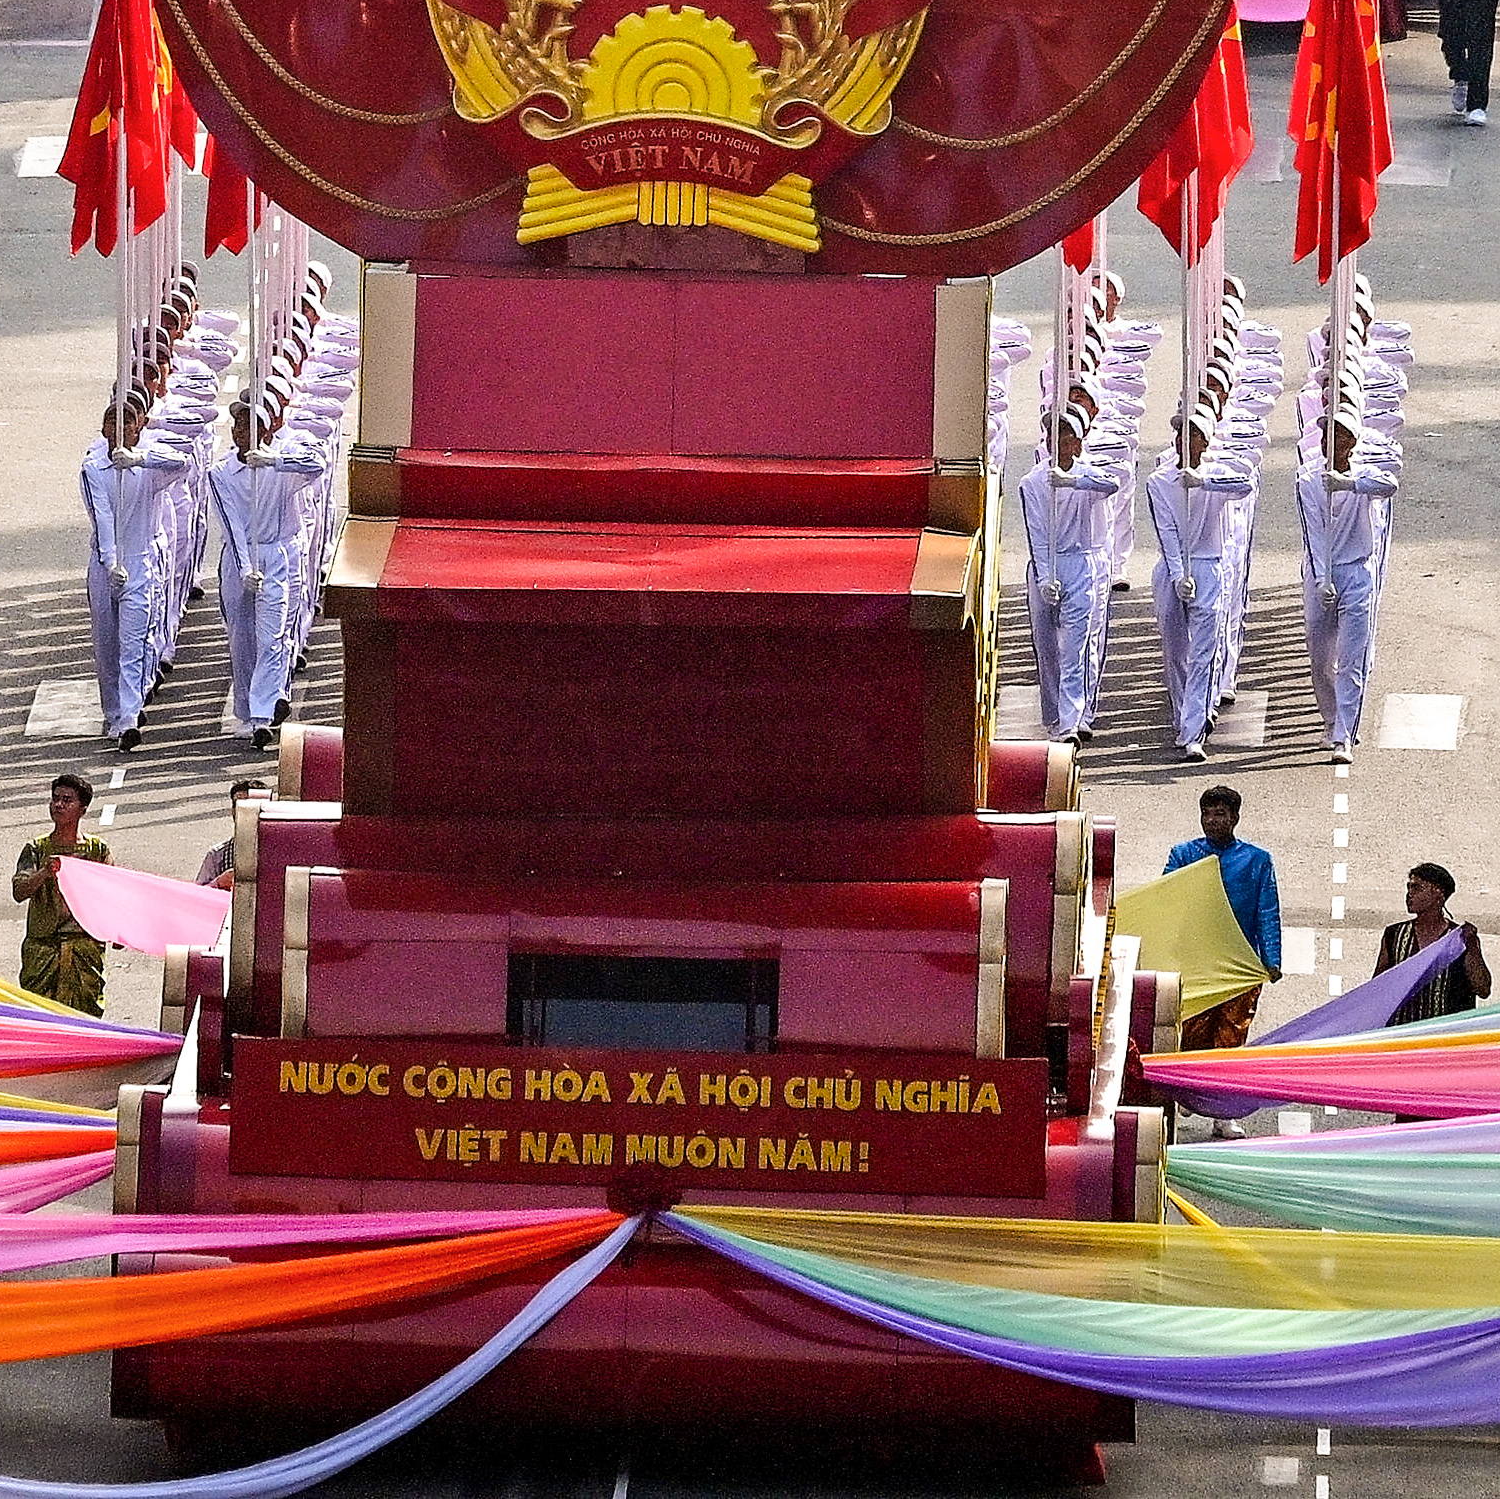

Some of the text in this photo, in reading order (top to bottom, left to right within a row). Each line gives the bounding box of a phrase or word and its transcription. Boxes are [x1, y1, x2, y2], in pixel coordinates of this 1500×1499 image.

[584, 141, 758, 185] VIỆT NAM
[279, 1054, 1003, 1114] NƯỚC CỘNG HÒA XÃ HỘI CHỦ NGHĨA
[415, 1124, 871, 1173] VIỆT NAM MUÔN NĂM!
